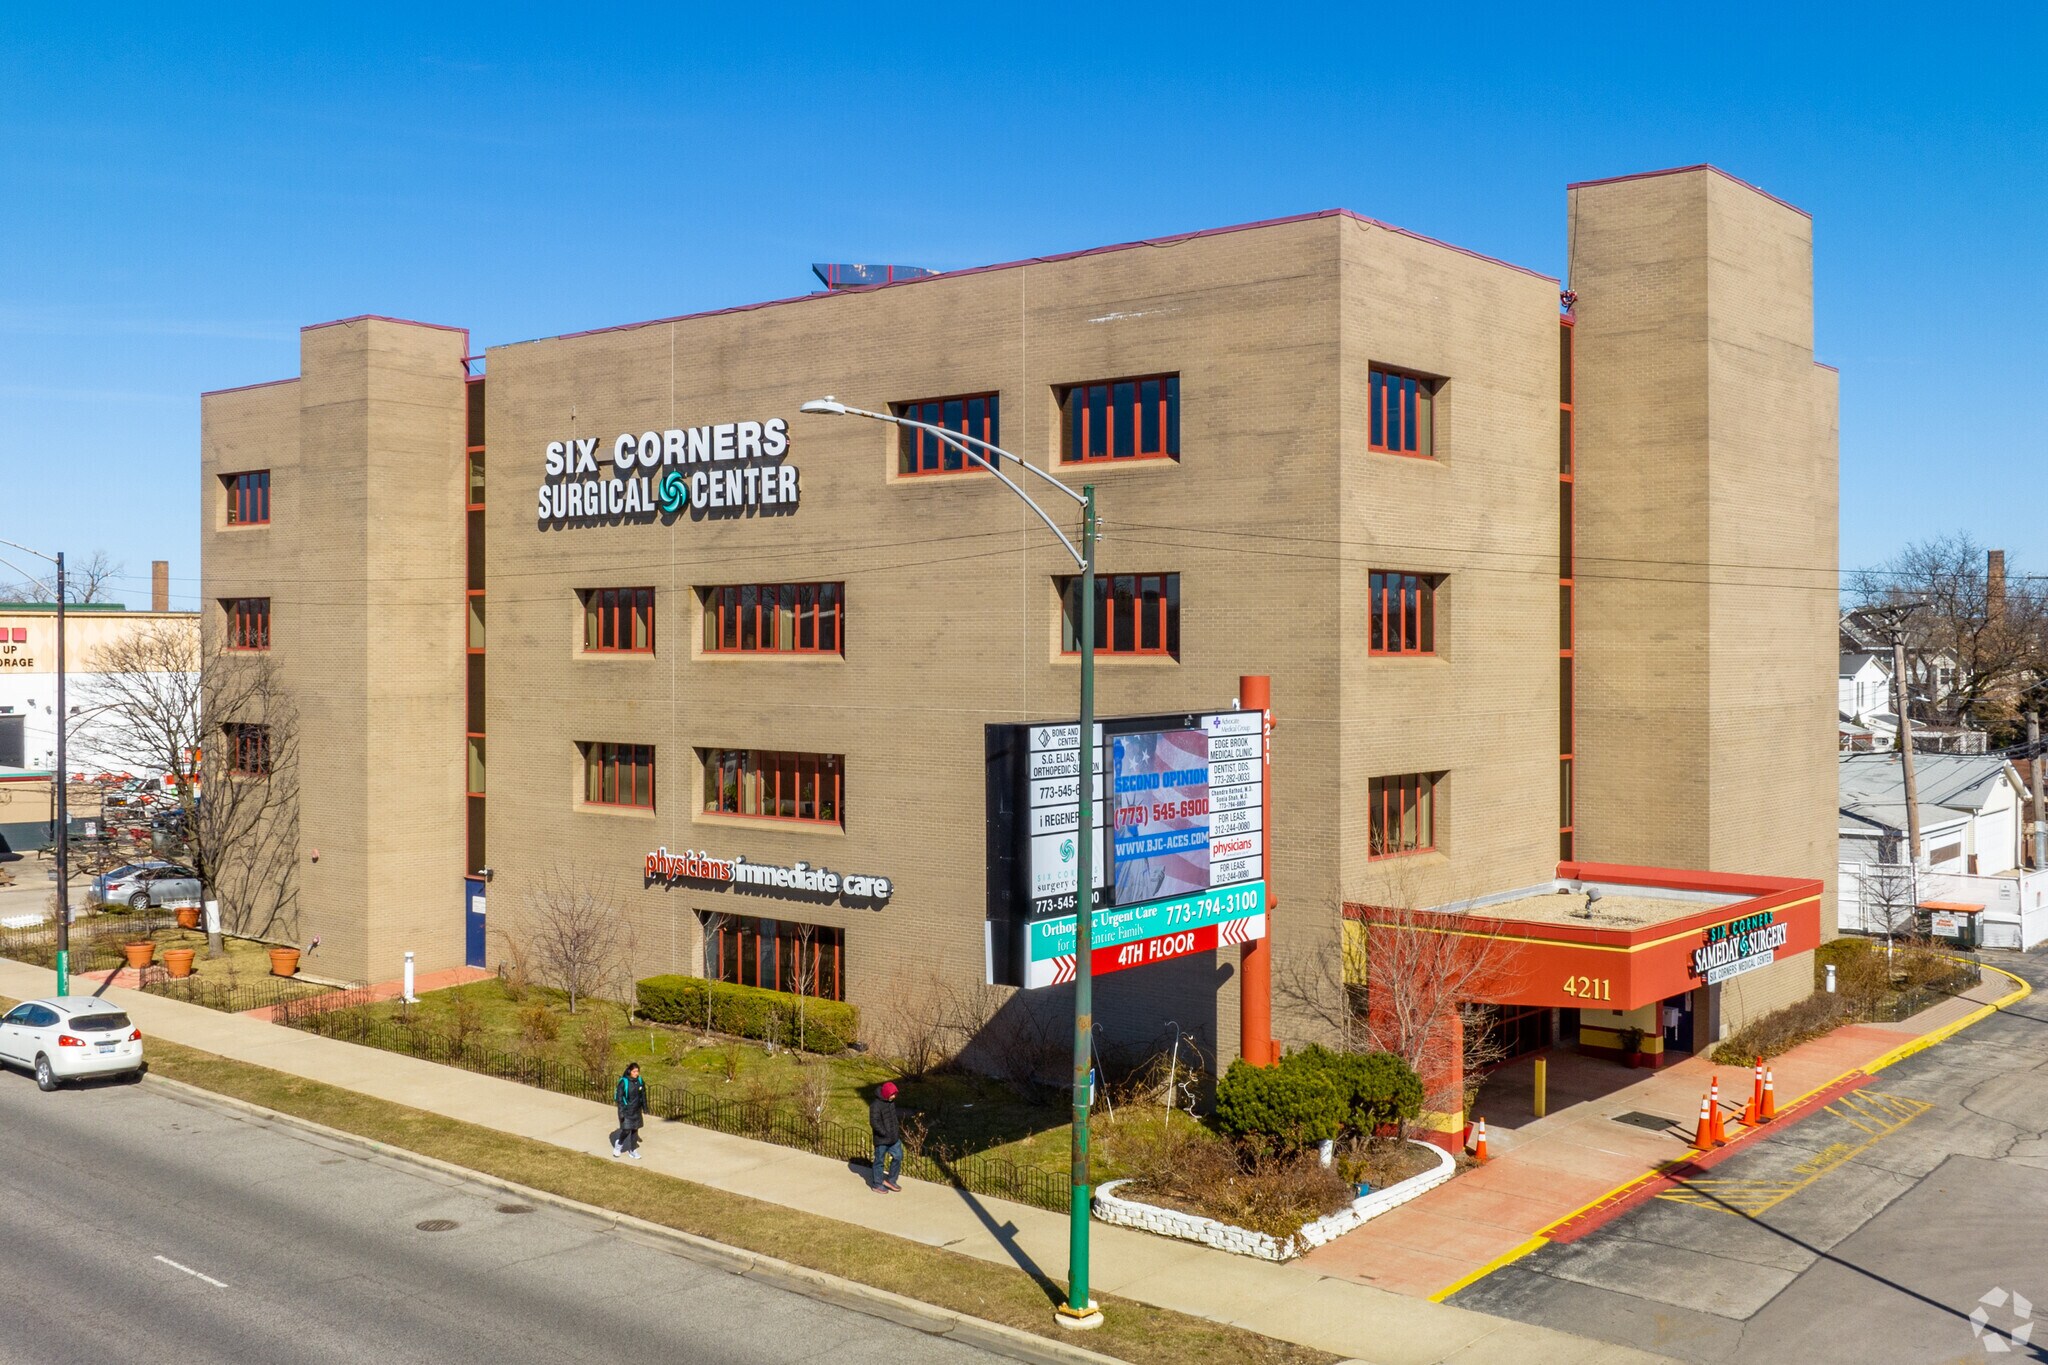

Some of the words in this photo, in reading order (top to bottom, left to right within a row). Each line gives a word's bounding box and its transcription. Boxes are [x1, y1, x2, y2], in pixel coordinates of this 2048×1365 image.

[545, 437, 598, 476] SIX
[614, 418, 788, 470] CORNERS
[538, 476, 656, 520] SURGICAL
[691, 465, 798, 509] CENTER
[3, 645, 17, 655] UP
[1052, 728, 1066, 737] BONE
[1067, 727, 1079, 737] AND
[1057, 737, 1080, 747] CENTER,
[1214, 738, 1229, 749] EDGE
[1230, 737, 1249, 748] BROOK
[1041, 754, 1055, 765] S.G.
[1056, 752, 1077, 763] ELIAS,
[1210, 750, 1234, 760] MEDICAL
[1235, 747, 1253, 758] CLINIC
[1033, 764, 1072, 777] ORTHOPEDIC
[1072, 761, 1100, 774] SUON
[1213, 772, 1250, 784] 773-282-0033
[1115, 773, 1160, 793] SECOND
[1162, 768, 1208, 788] OPINION
[1040, 783, 1094, 800] 773-545-6
[1044, 811, 1094, 827] REGENER
[1114, 806, 1149, 830] (773)
[1153, 798, 1209, 822] 545-6900
[1218, 813, 1229, 824] FOR
[1229, 810, 1246, 822] LEASE
[1115, 831, 1209, 857] WWW.BJC-ACES.COM
[1212, 838, 1252, 858] physicians
[645, 846, 736, 881] physicians
[736, 856, 838, 893] immediate
[842, 873, 891, 898] care
[1220, 863, 1230, 873] FOR
[1230, 860, 1246, 871] LEASE
[1037, 873, 1052, 882] SIX
[1037, 880, 1070, 893] surgery
[1166, 890, 1258, 926] 773-794-3100
[1042, 919, 1098, 938] Orthopc
[1100, 911, 1134, 928] Urgent
[1135, 906, 1158, 919] Care
[1711, 924, 1727, 942] SIX
[1732, 911, 1774, 935] CORNERS
[1057, 937, 1070, 952] for
[1117, 923, 1145, 938] Family
[1695, 936, 1740, 973] SAMEDAY
[1748, 922, 1788, 955] SURGERY
[1117, 943, 1143, 966] 4TH
[1149, 932, 1195, 960] FLOOR
[1709, 971, 1718, 982] SIX
[1718, 964, 1738, 979] CORNERS
[1739, 958, 1756, 972] MEDICAL
[1757, 952, 1772, 966] CENTER
[1563, 975, 1611, 1001] 4211
